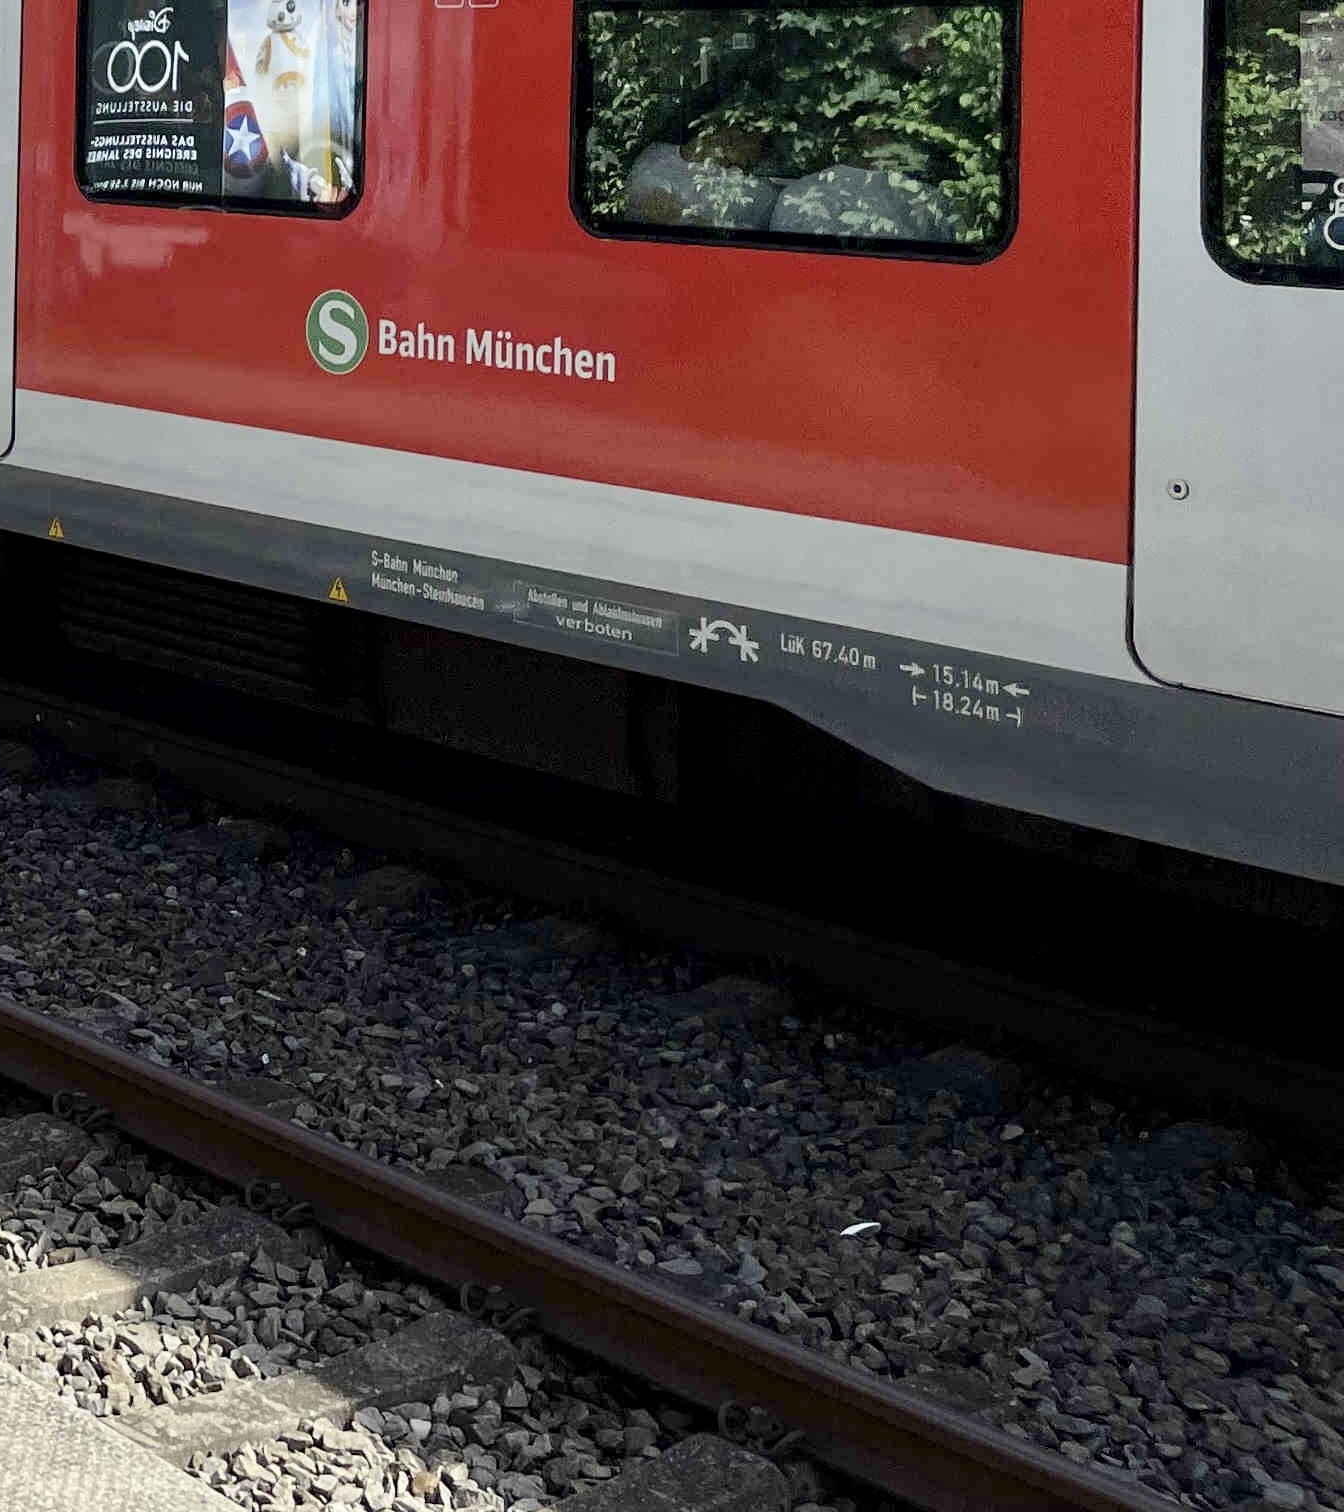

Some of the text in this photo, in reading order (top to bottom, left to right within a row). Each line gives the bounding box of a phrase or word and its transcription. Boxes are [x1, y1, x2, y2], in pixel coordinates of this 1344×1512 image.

[378, 319, 455, 362] Bahn
[466, 328, 616, 382] München
[371, 549, 459, 584] S-Bahn München
[555, 615, 633, 641] verboten
[812, 639, 860, 667] 67.40
[863, 651, 877, 670] m
